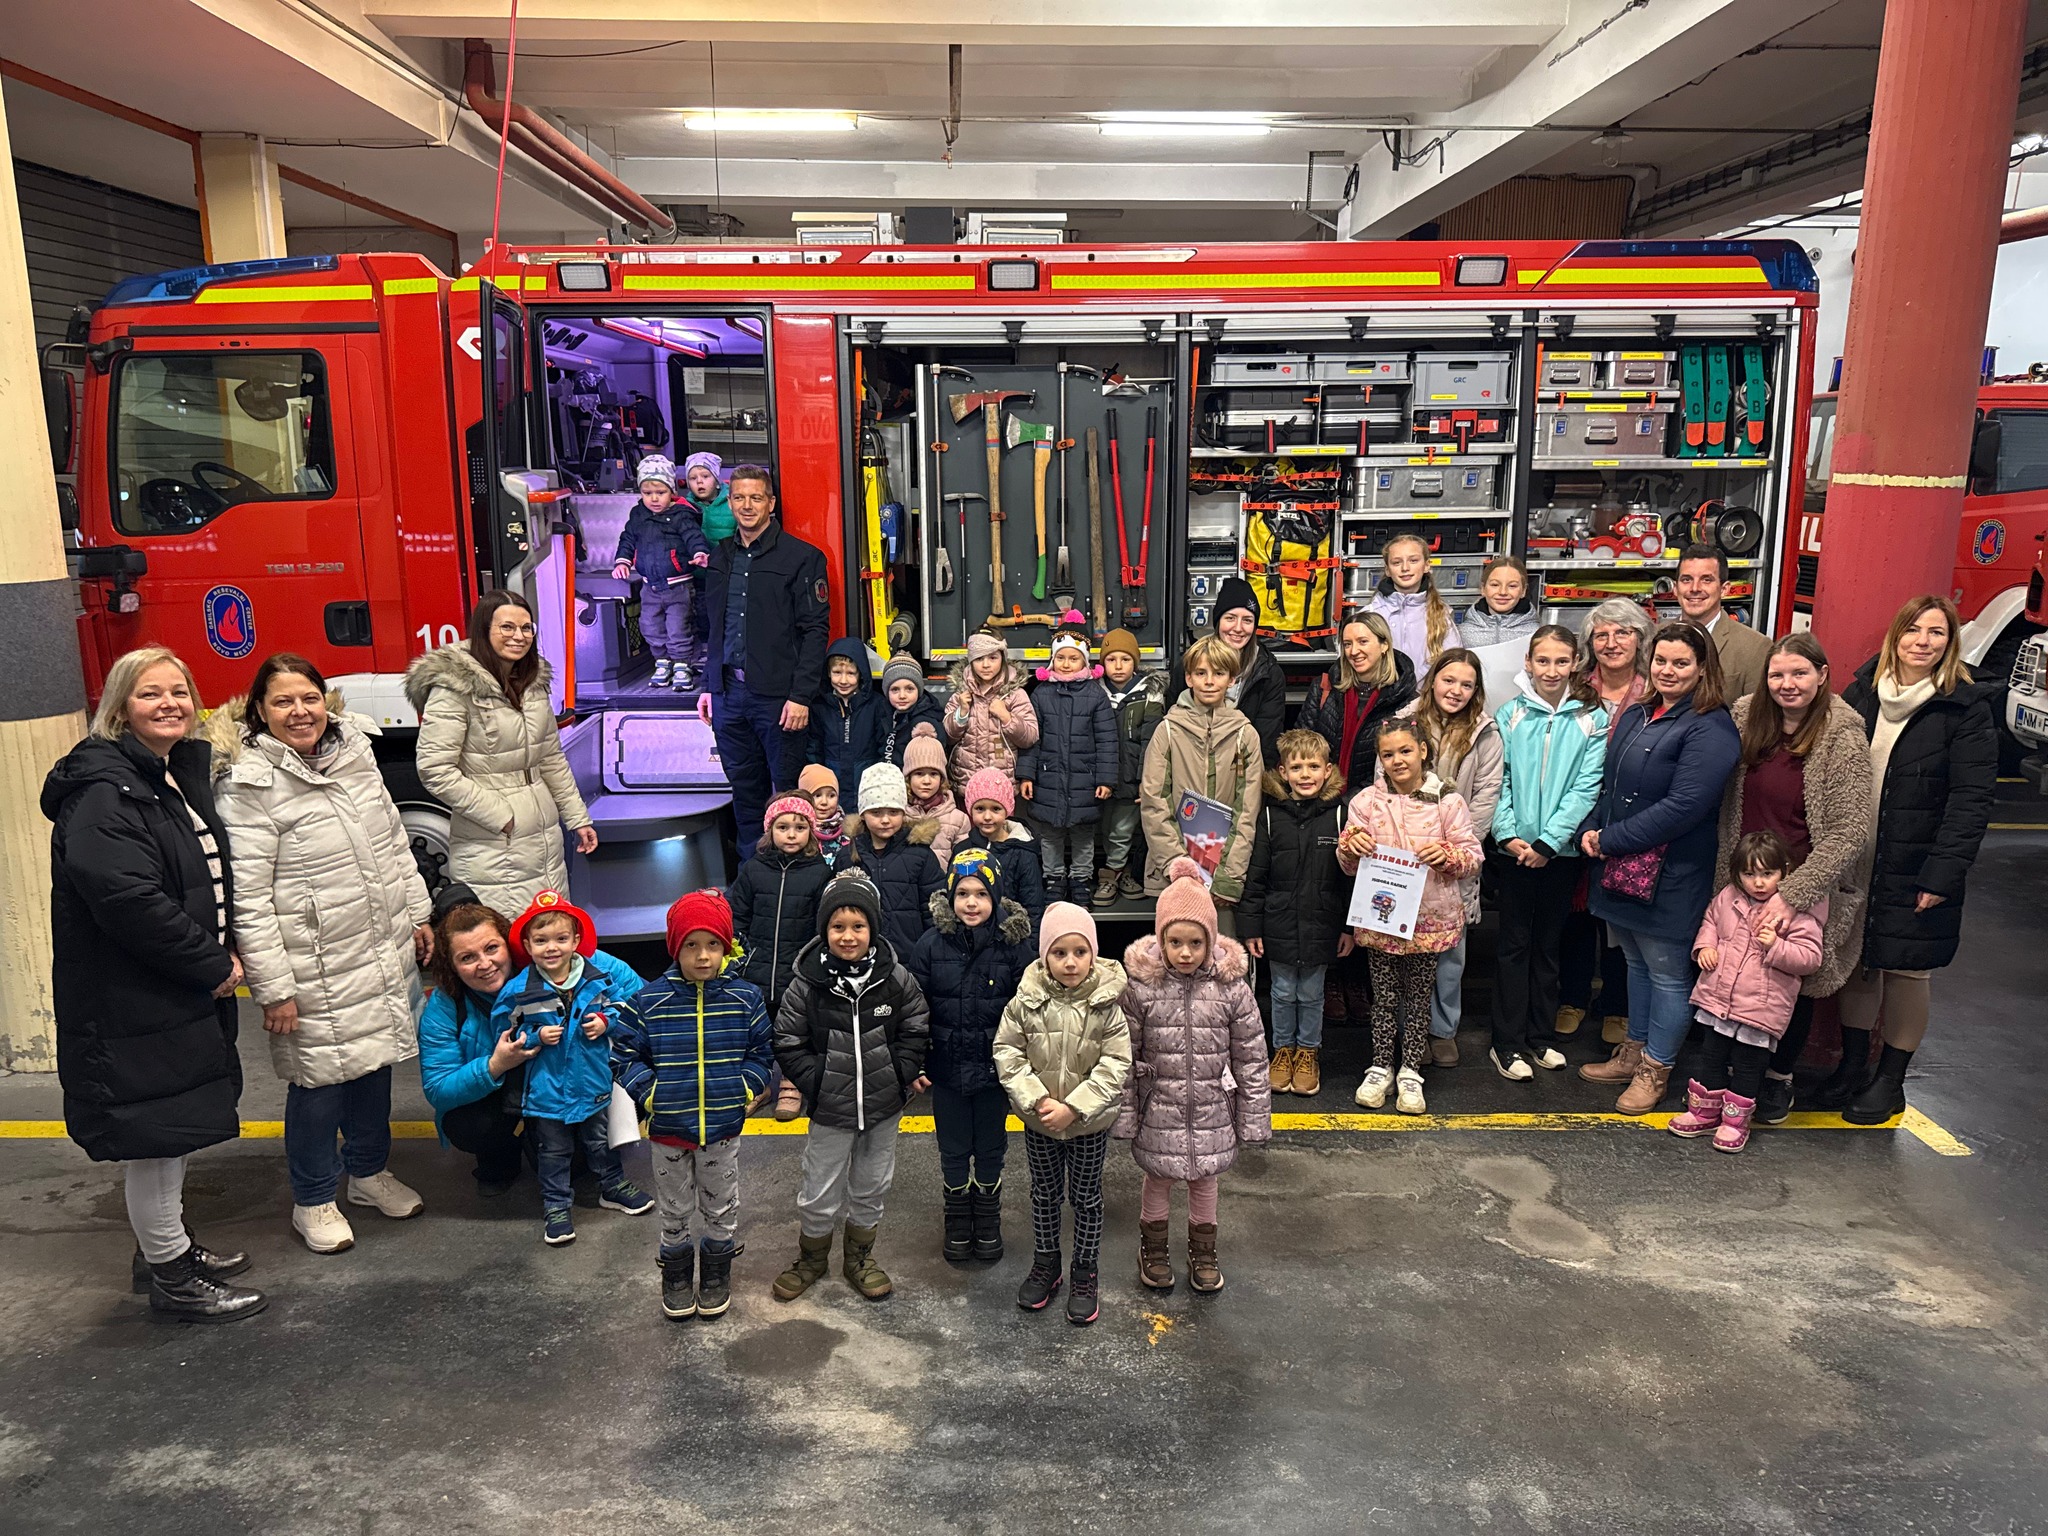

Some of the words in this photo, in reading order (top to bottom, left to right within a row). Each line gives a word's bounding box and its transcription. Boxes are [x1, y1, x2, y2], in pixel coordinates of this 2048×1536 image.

[1689, 353, 1698, 365] C
[1714, 352, 1722, 364] C
[1750, 351, 1758, 363] B
[1692, 402, 1700, 415] C
[1713, 401, 1723, 414] C
[1753, 401, 1761, 413] B
[297, 562, 345, 574] 13.290
[245, 606, 253, 630] CENTER
[212, 642, 230, 656] NOVO
[233, 641, 253, 657] MESTO
[2023, 711, 2037, 729] NM
[1369, 853, 1420, 869] RIZNANJE
